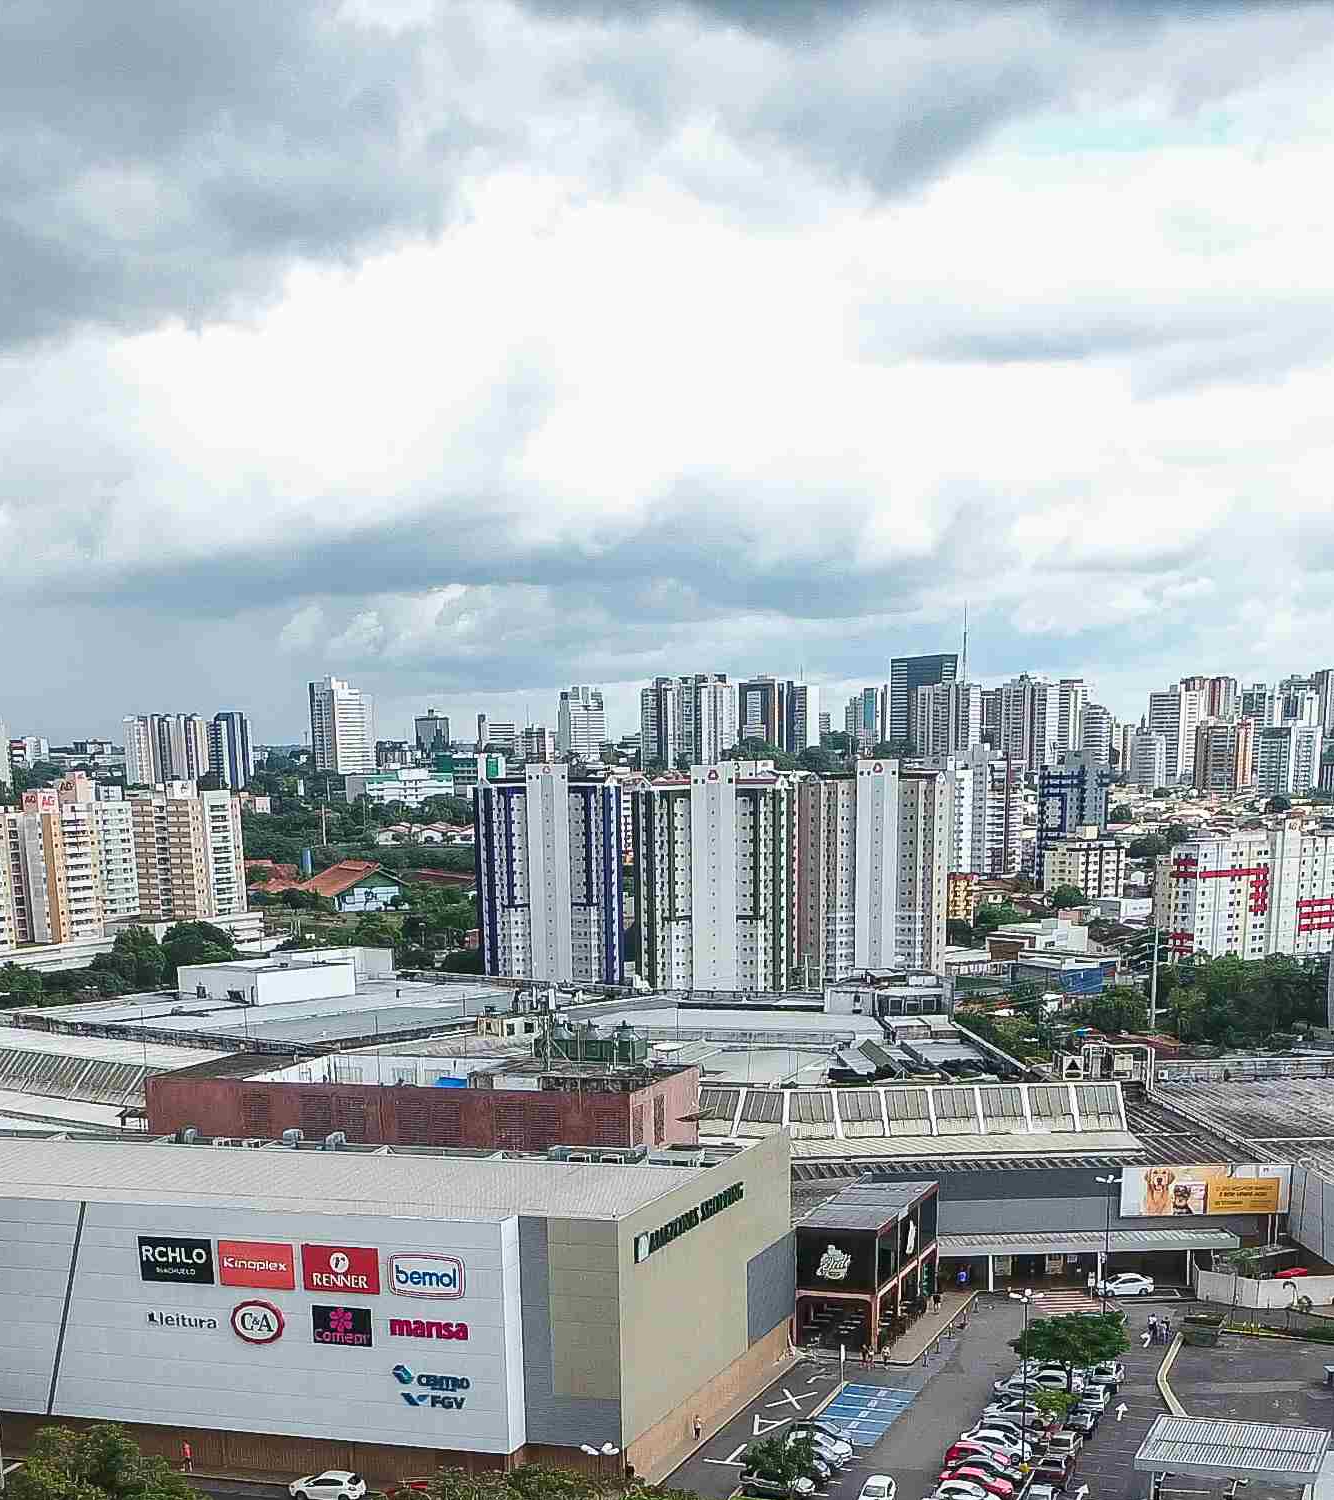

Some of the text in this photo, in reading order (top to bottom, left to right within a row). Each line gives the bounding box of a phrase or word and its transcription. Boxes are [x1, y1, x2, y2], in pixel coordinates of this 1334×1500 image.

[141, 1245, 206, 1264] RCHLO
[223, 1256, 287, 1272] Kinoplex
[312, 1272, 369, 1289] RENNER
[394, 1264, 457, 1288] bemol
[160, 1311, 218, 1329] leitura
[241, 1312, 273, 1332] C&A
[389, 1318, 468, 1341] marisa
[430, 1395, 466, 1410] FGV
